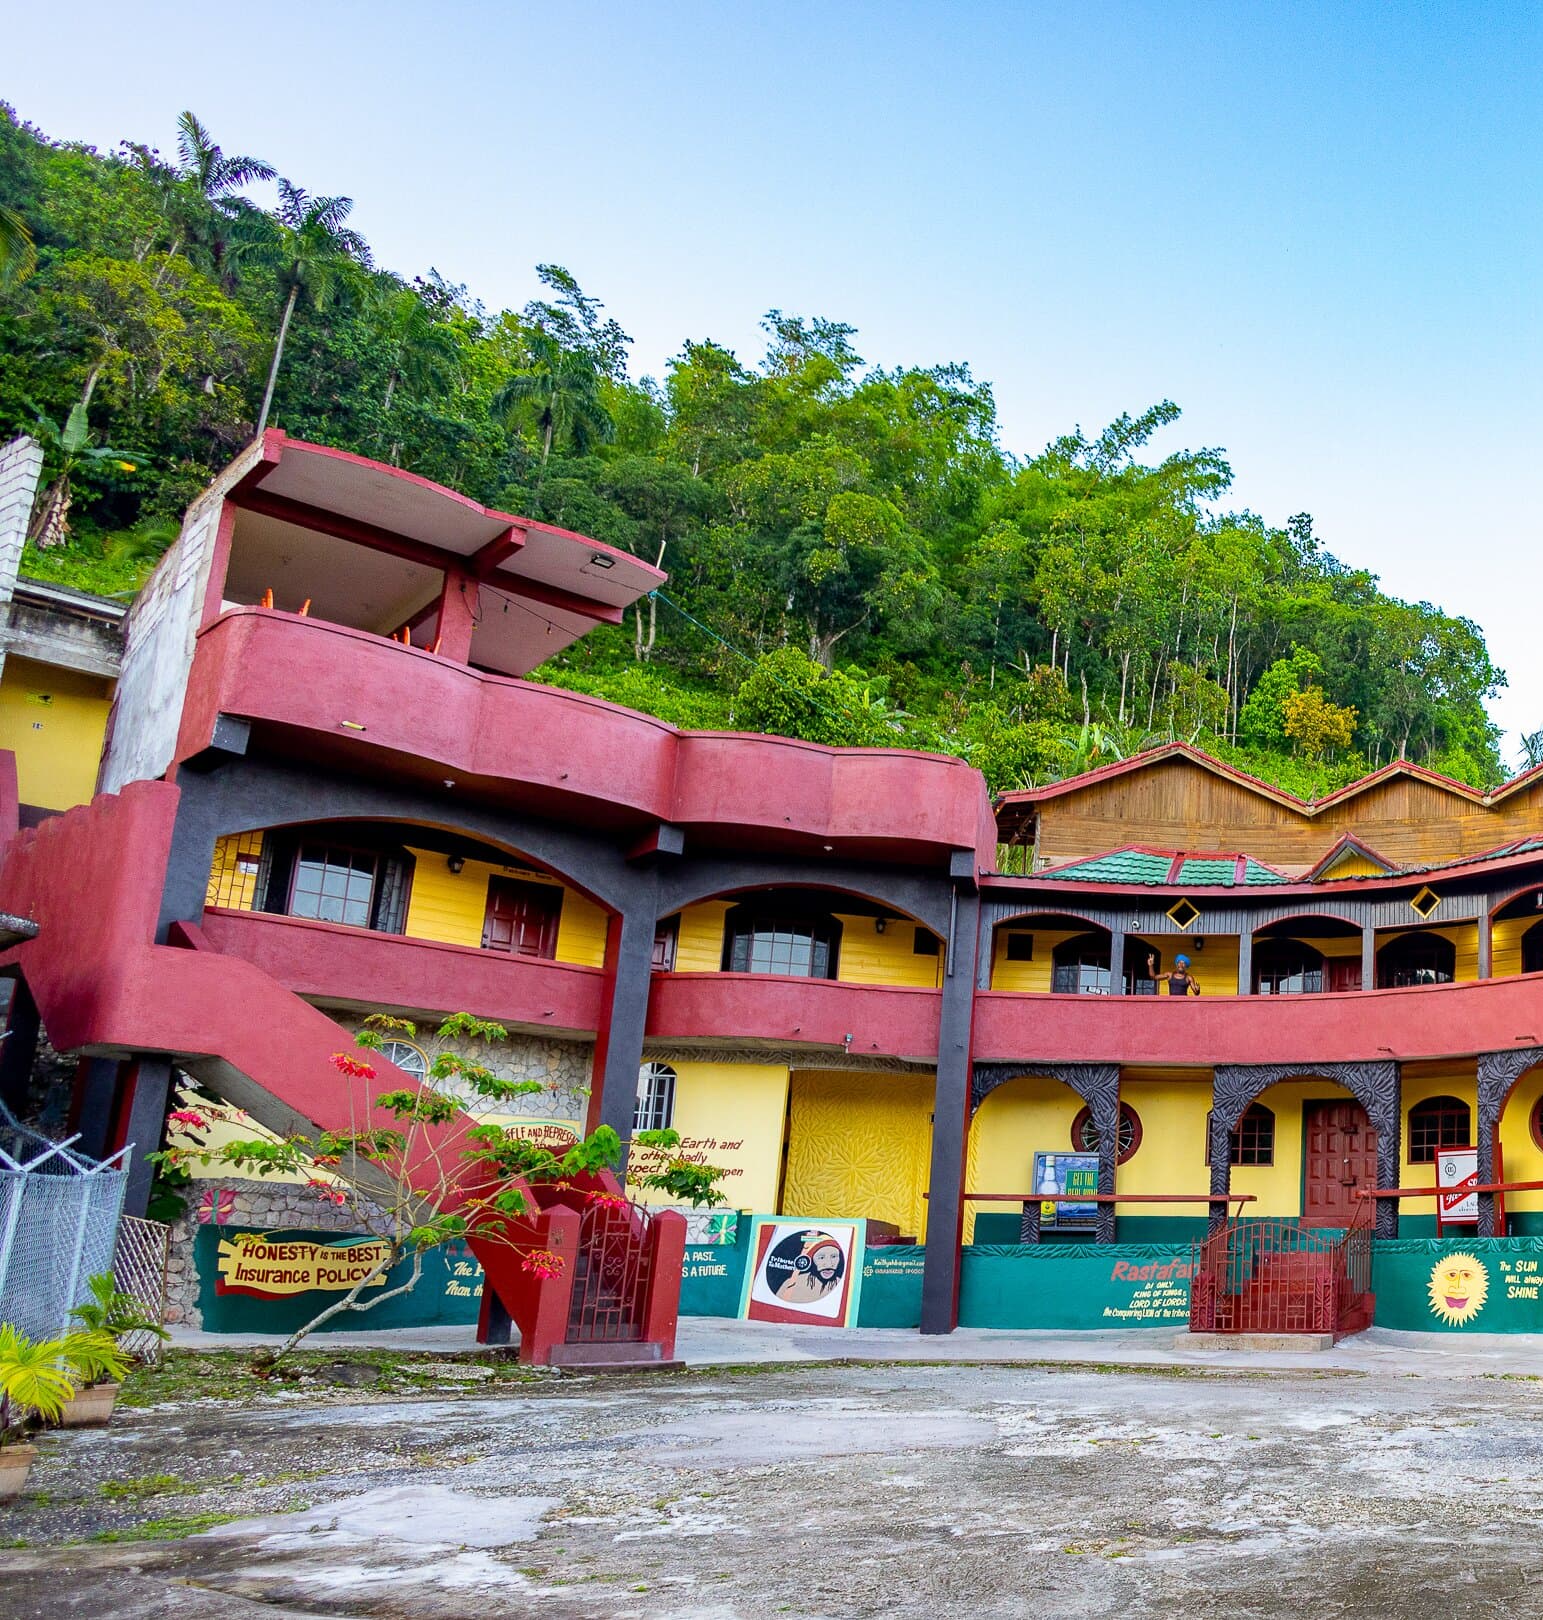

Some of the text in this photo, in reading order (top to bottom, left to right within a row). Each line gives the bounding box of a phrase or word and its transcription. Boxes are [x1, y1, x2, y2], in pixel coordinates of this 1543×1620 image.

[681, 1137, 717, 1150] Earth
[719, 1139, 744, 1150] and
[678, 1150, 708, 1165] badly
[242, 1244, 317, 1262] HONESTY
[331, 1251, 346, 1261] THE
[348, 1246, 382, 1263] BEST
[453, 1261, 473, 1276] The
[690, 1266, 697, 1277] A
[1500, 1260, 1538, 1272] The SUN
[235, 1263, 310, 1283] Insurance
[445, 1280, 471, 1296] Than
[1133, 1290, 1152, 1298] KING
[1506, 1286, 1538, 1299] SHINE
[1129, 1298, 1187, 1308] LORD OF LORDS
